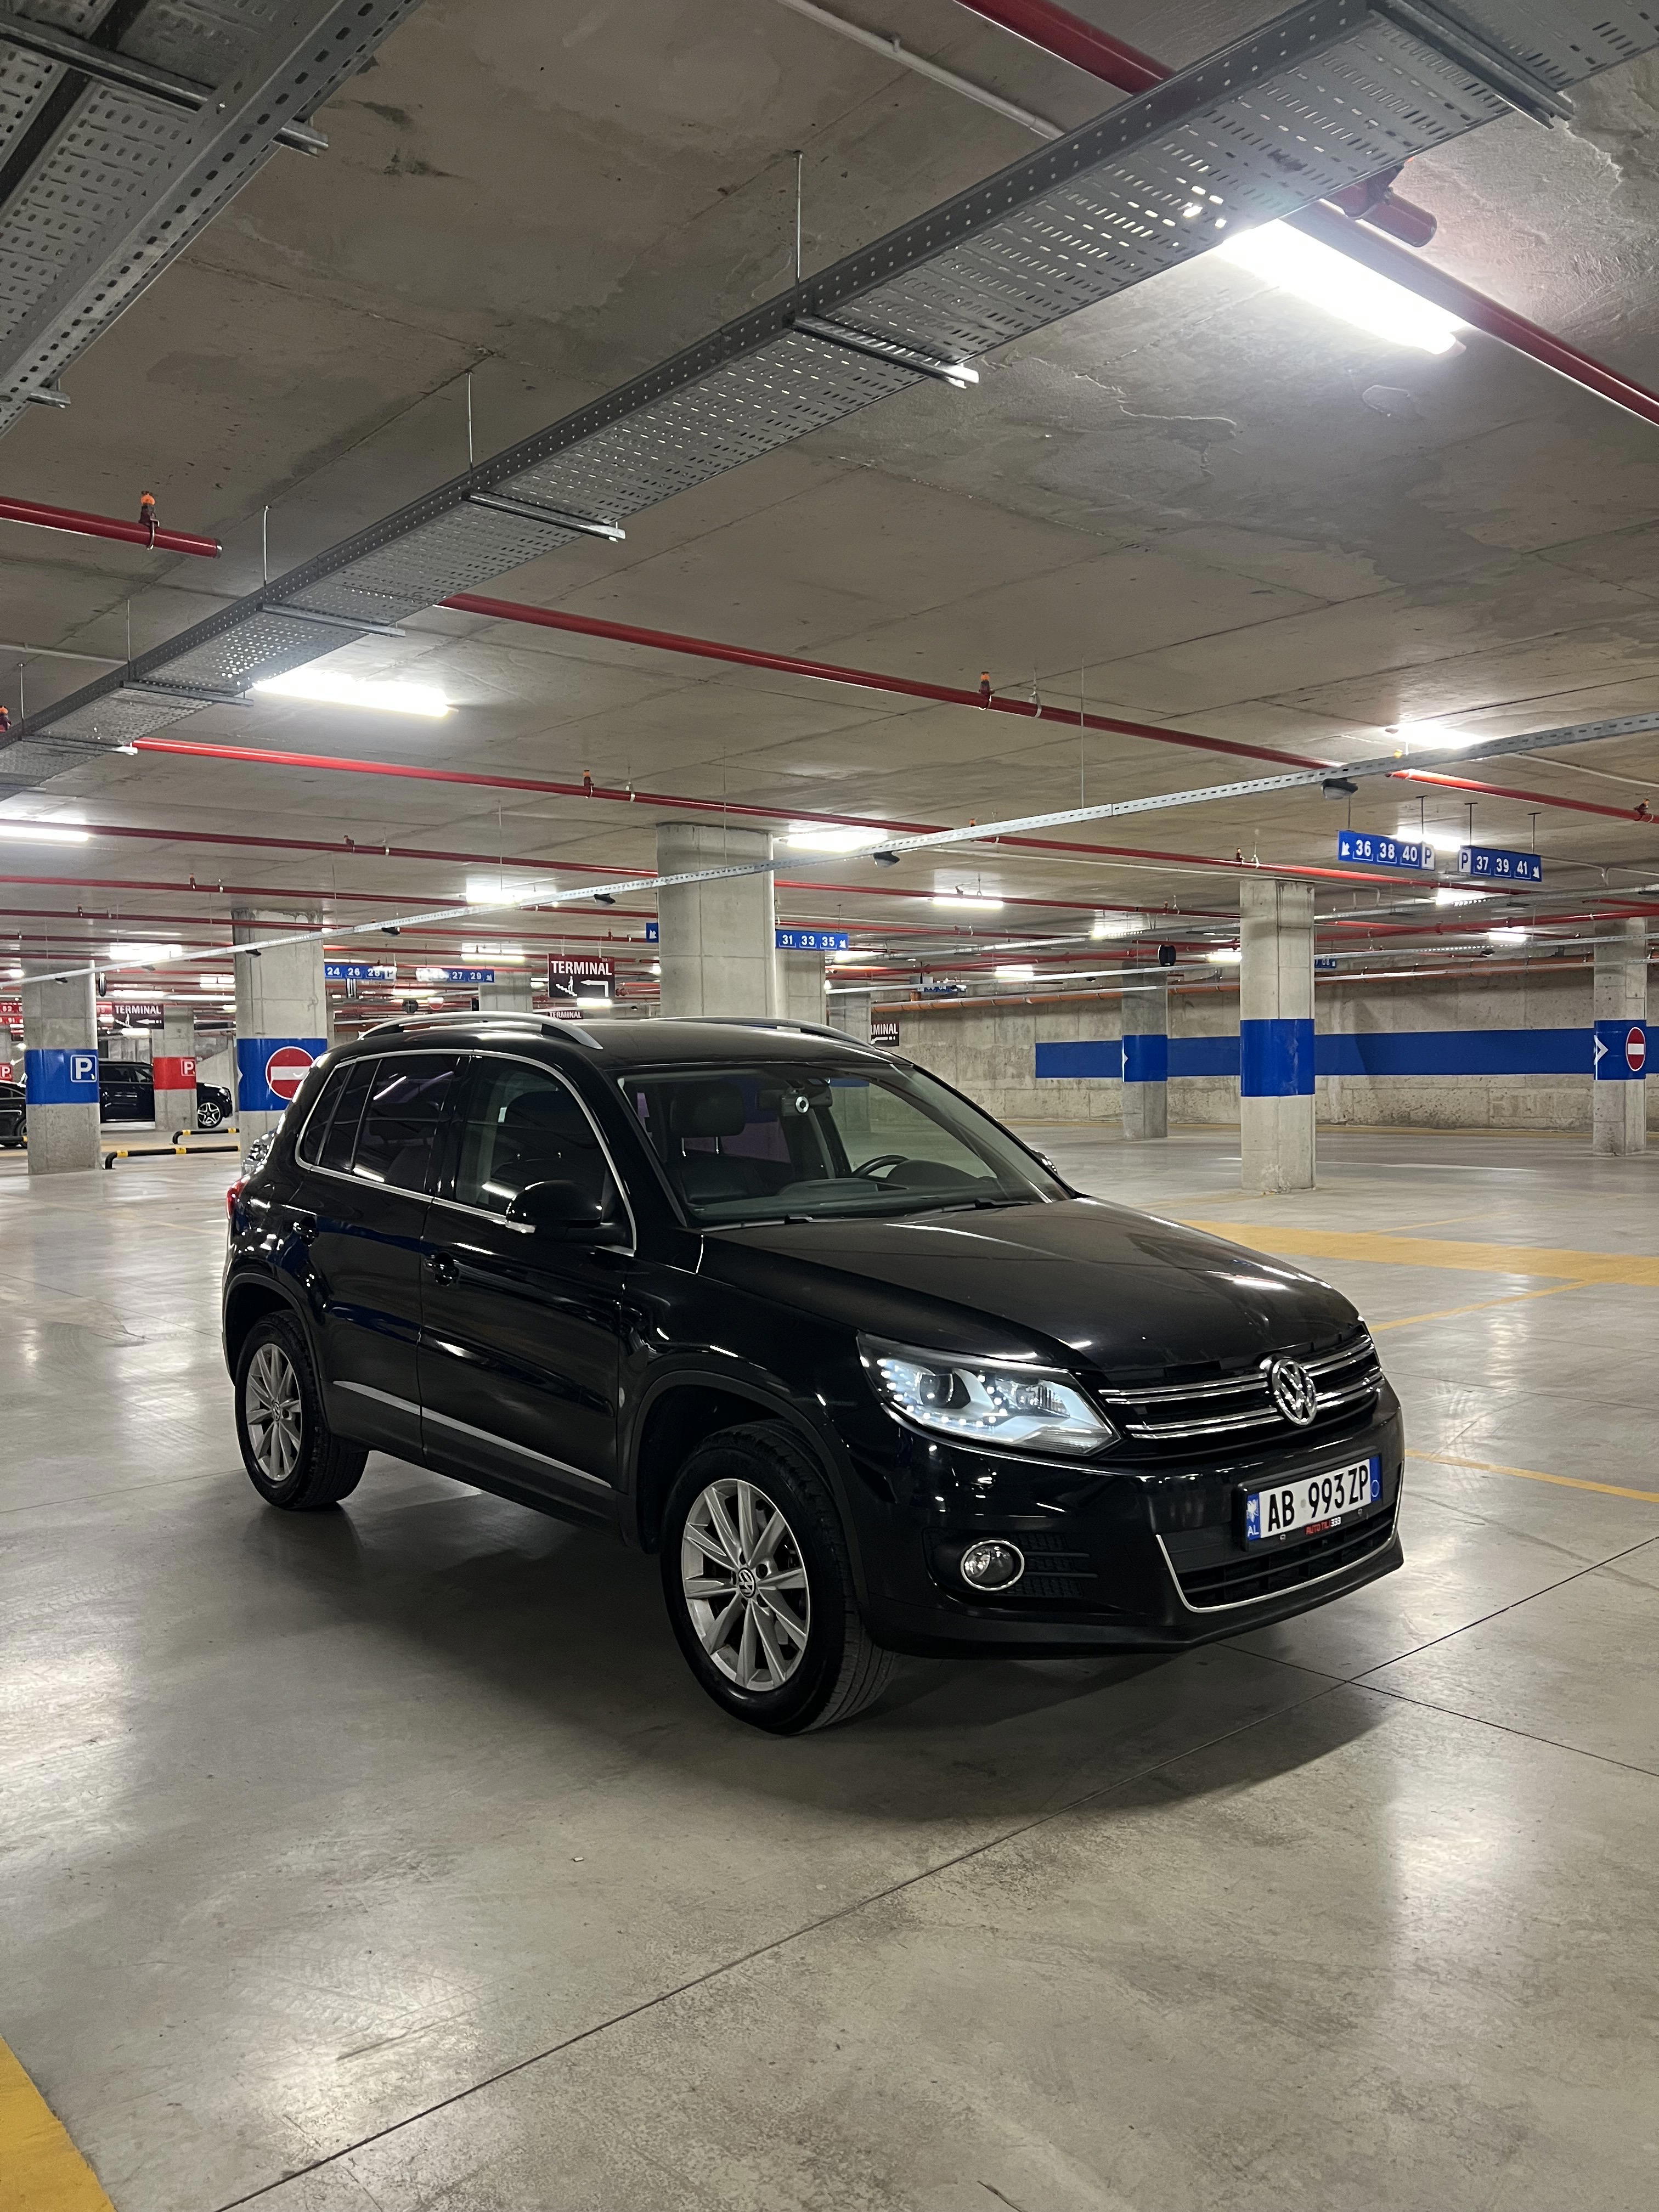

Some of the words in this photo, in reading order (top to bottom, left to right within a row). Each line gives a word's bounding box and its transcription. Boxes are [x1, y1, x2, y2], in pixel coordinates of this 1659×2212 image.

[1356, 839, 1372, 856] 36
[1379, 842, 1395, 859] 38
[1402, 845, 1418, 862] 40
[1425, 847, 1432, 865] P
[1462, 852, 1469, 869] P
[1476, 855, 1489, 871] 37
[1496, 857, 1509, 873] 39
[1517, 860, 1527, 875] 41
[782, 934, 793, 945] 31
[801, 935, 815, 946] 33
[822, 936, 835, 947] 35
[327, 967, 340, 975] 24
[347, 967, 360, 976] 26
[368, 968, 380, 977] 28
[551, 960, 612, 975] TERMINAL
[470, 972, 482, 980] 29
[114, 1005, 161, 1014] TERMINAL
[2, 1066, 10, 1077] P
[75, 1057, 93, 1080] P
[184, 1061, 194, 1075] P
[1268, 1490, 1295, 1532] AB
[1308, 1471, 1345, 1519] 993
[1348, 1464, 1369, 1505] ZP
[1247, 1525, 1260, 1537] AL
